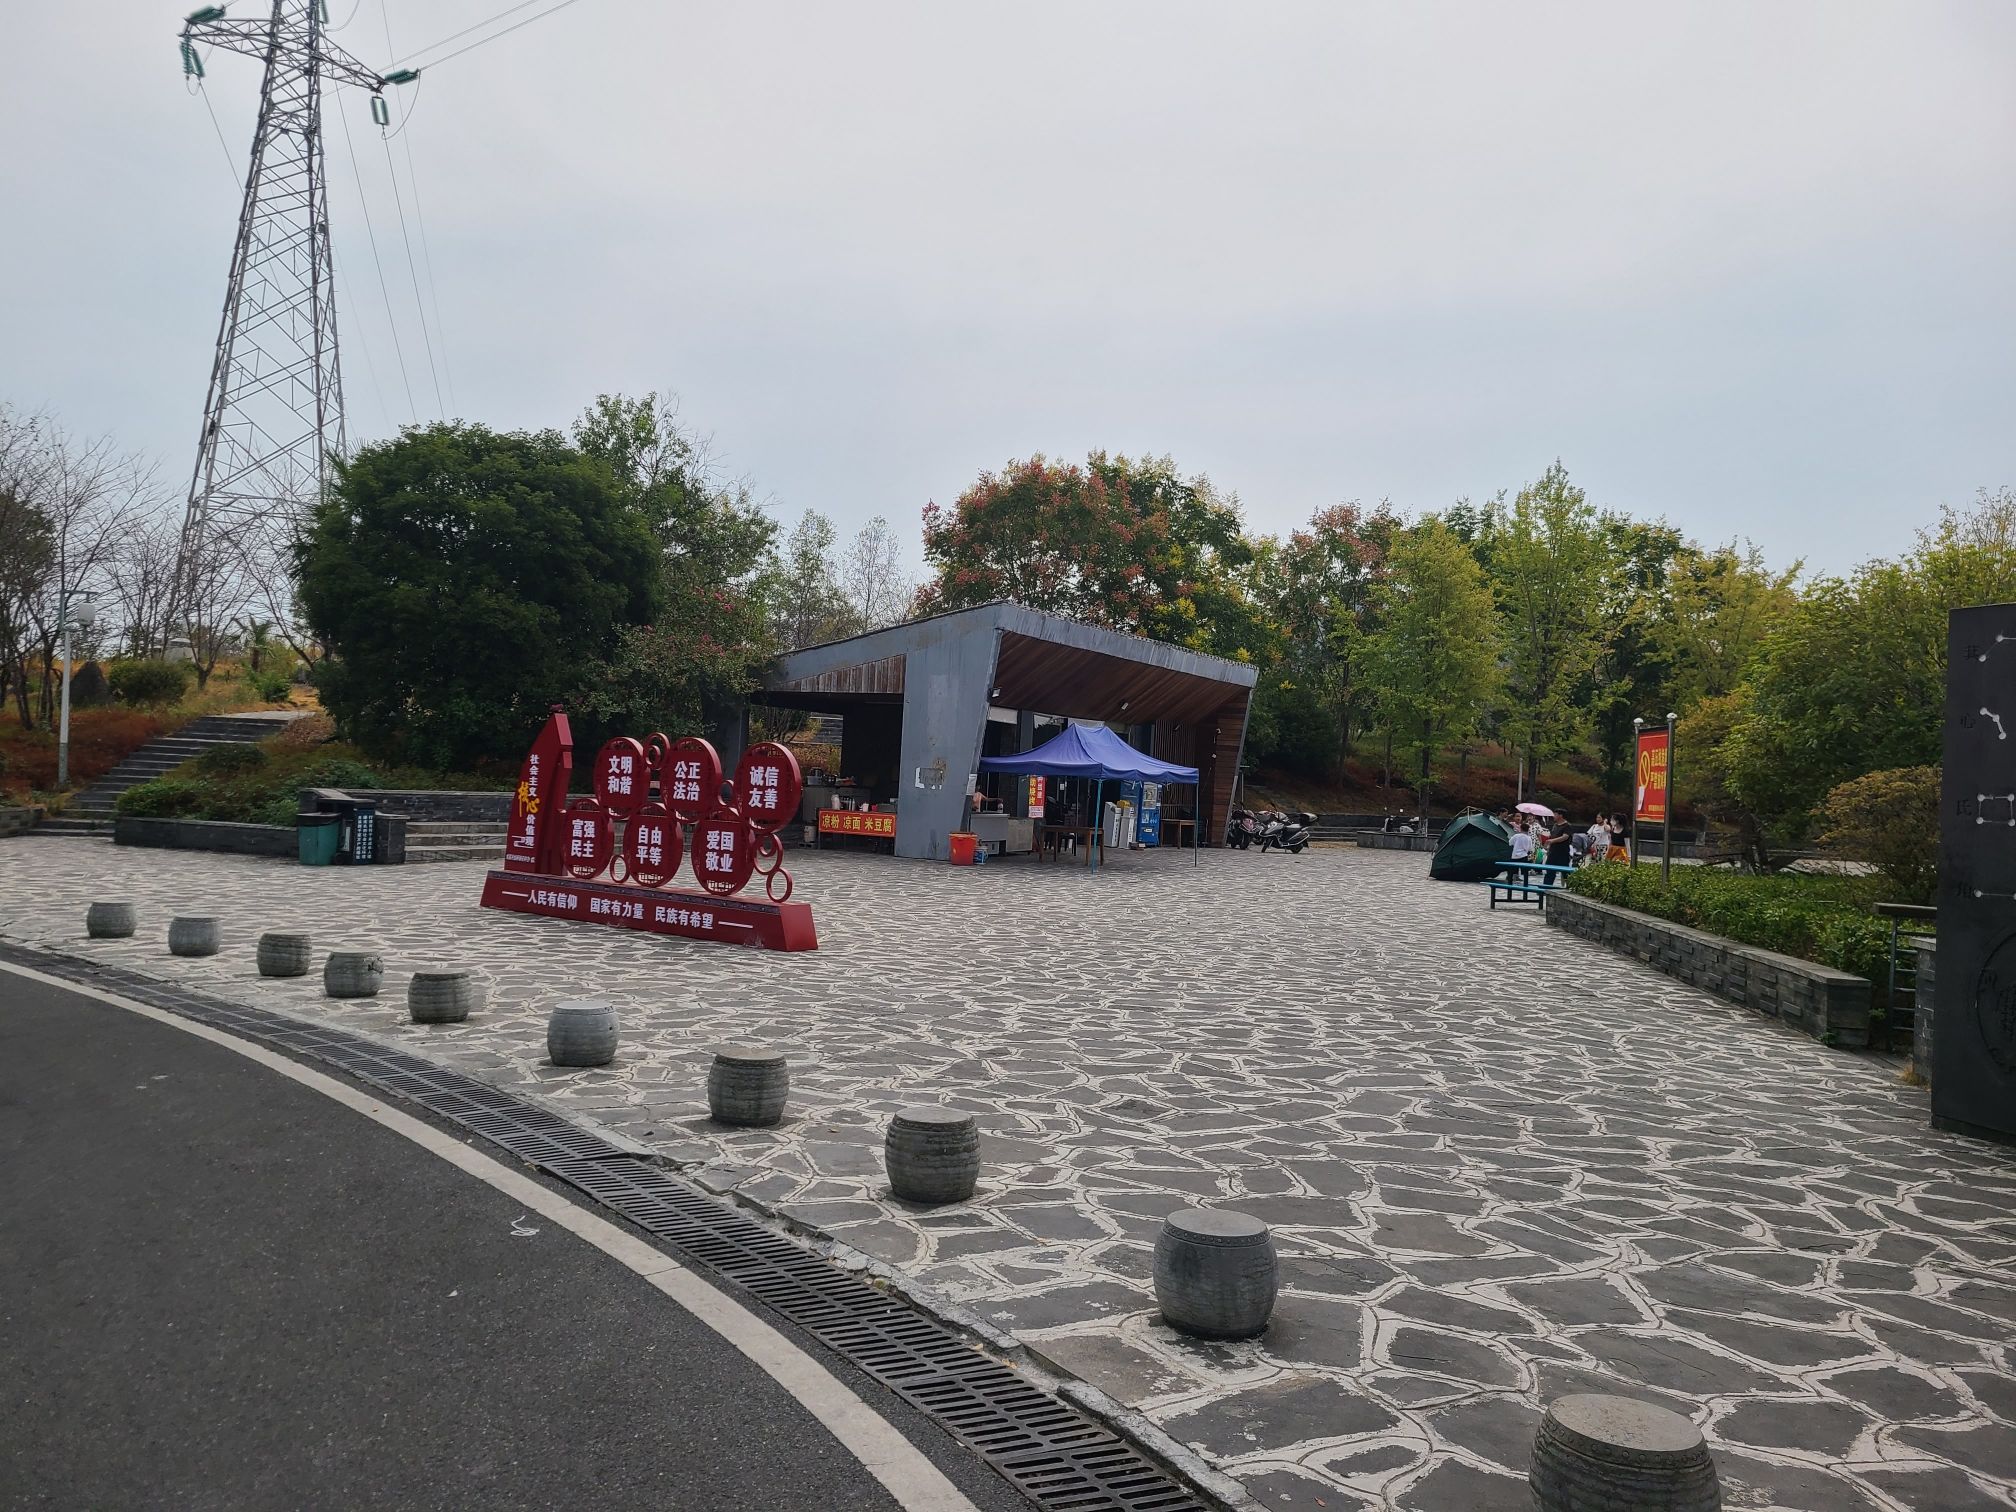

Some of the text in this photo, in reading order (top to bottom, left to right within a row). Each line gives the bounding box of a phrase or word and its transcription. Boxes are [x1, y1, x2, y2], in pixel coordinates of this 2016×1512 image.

[608, 755, 633, 774] 文明
[674, 760, 701, 780] 公正
[528, 754, 540, 797] 社会主义
[607, 775, 633, 795] 和谐
[749, 766, 780, 787] 诚信
[673, 781, 700, 801] 法治
[748, 788, 778, 809] 友善
[524, 814, 536, 847] 价值观
[571, 819, 595, 838] 富强
[822, 813, 893, 833] 凉粉 凉面 米豆腐
[638, 825, 662, 845] 自由
[706, 830, 734, 851] 爱国
[571, 840, 594, 857] 民主
[635, 845, 662, 866] 平等
[705, 851, 733, 873] 敬业
[528, 889, 714, 930] 人民有信仰 国家有力量 民族有希望
